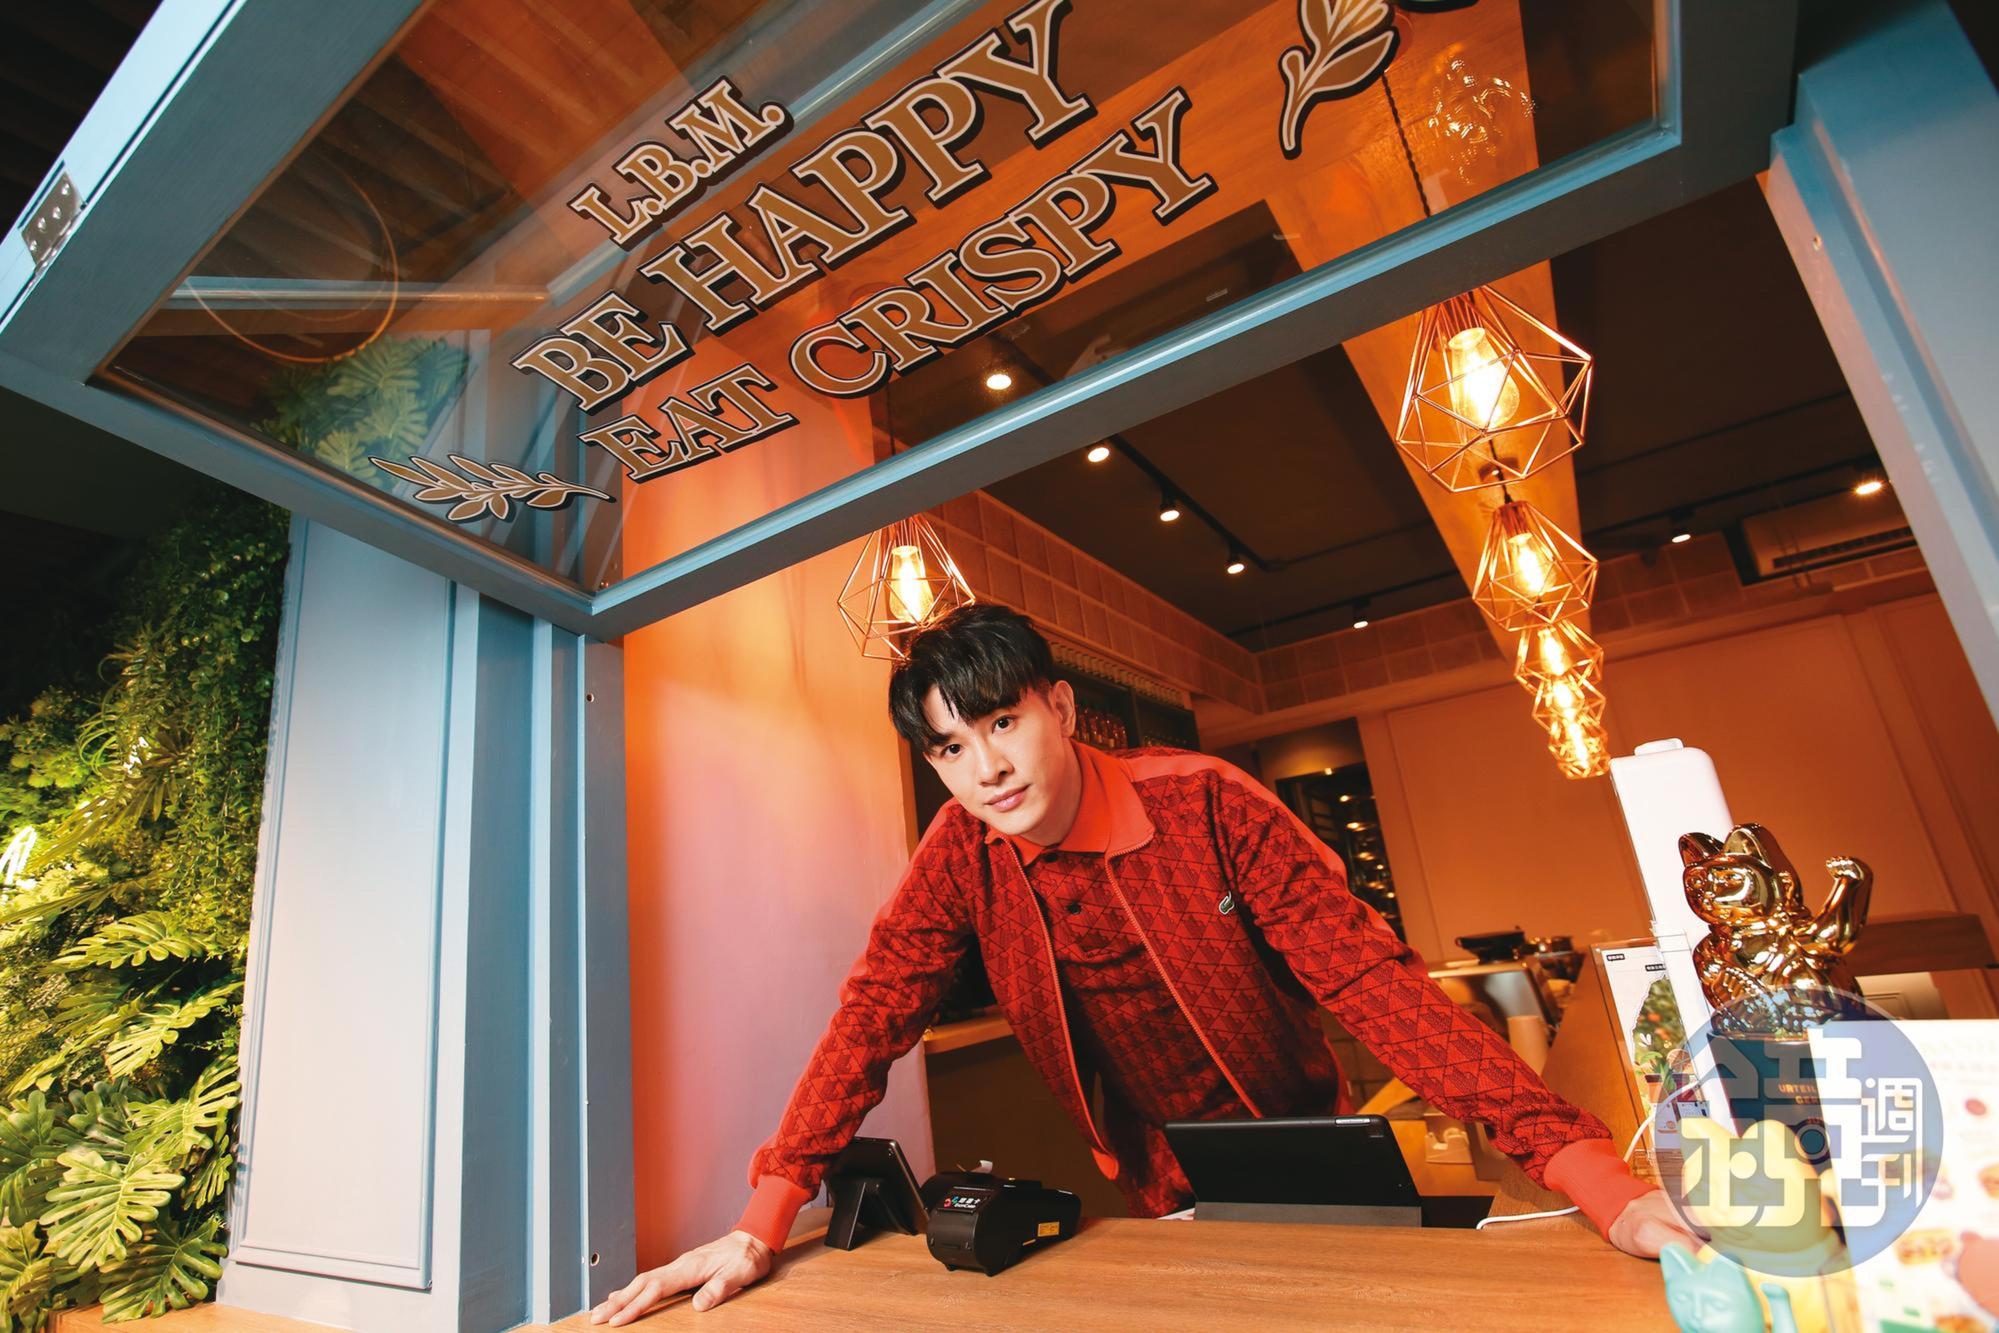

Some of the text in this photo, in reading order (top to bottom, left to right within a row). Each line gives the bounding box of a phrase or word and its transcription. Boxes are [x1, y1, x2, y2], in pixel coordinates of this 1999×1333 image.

[509, 0, 1098, 416] BE HAPPY
[567, 75, 794, 250] L.B.M.
[576, 85, 1219, 484] EAT CRISPY
